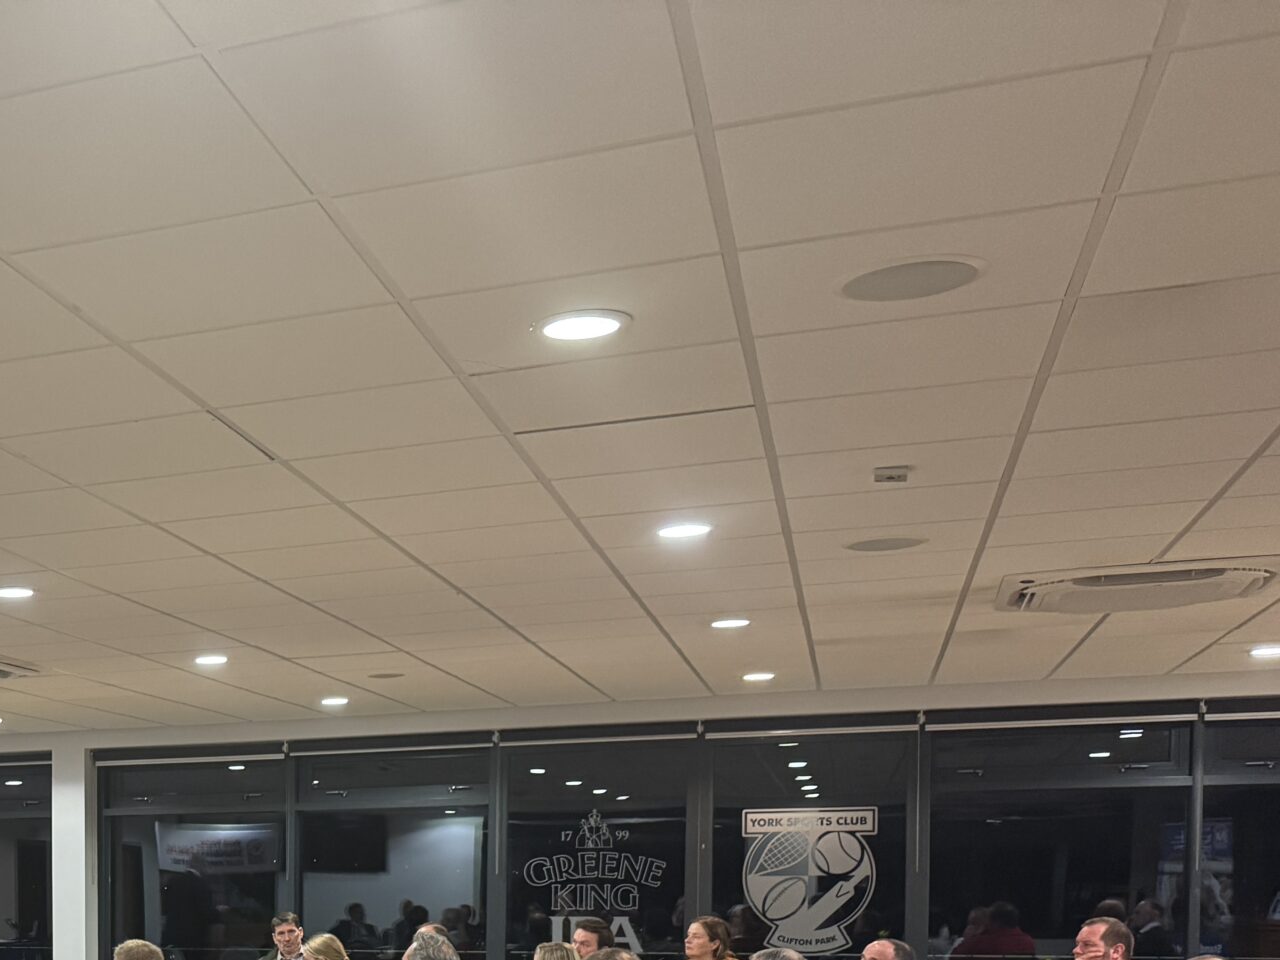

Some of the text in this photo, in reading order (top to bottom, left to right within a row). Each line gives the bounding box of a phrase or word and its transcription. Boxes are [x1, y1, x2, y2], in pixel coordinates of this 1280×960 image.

[750, 818, 783, 827] YORK
[836, 816, 867, 826] CLUB
[561, 830, 630, 841] 17 99
[523, 851, 667, 887] GREENE
[551, 884, 639, 910] KING
[777, 935, 838, 946] CLIFTON PARK
